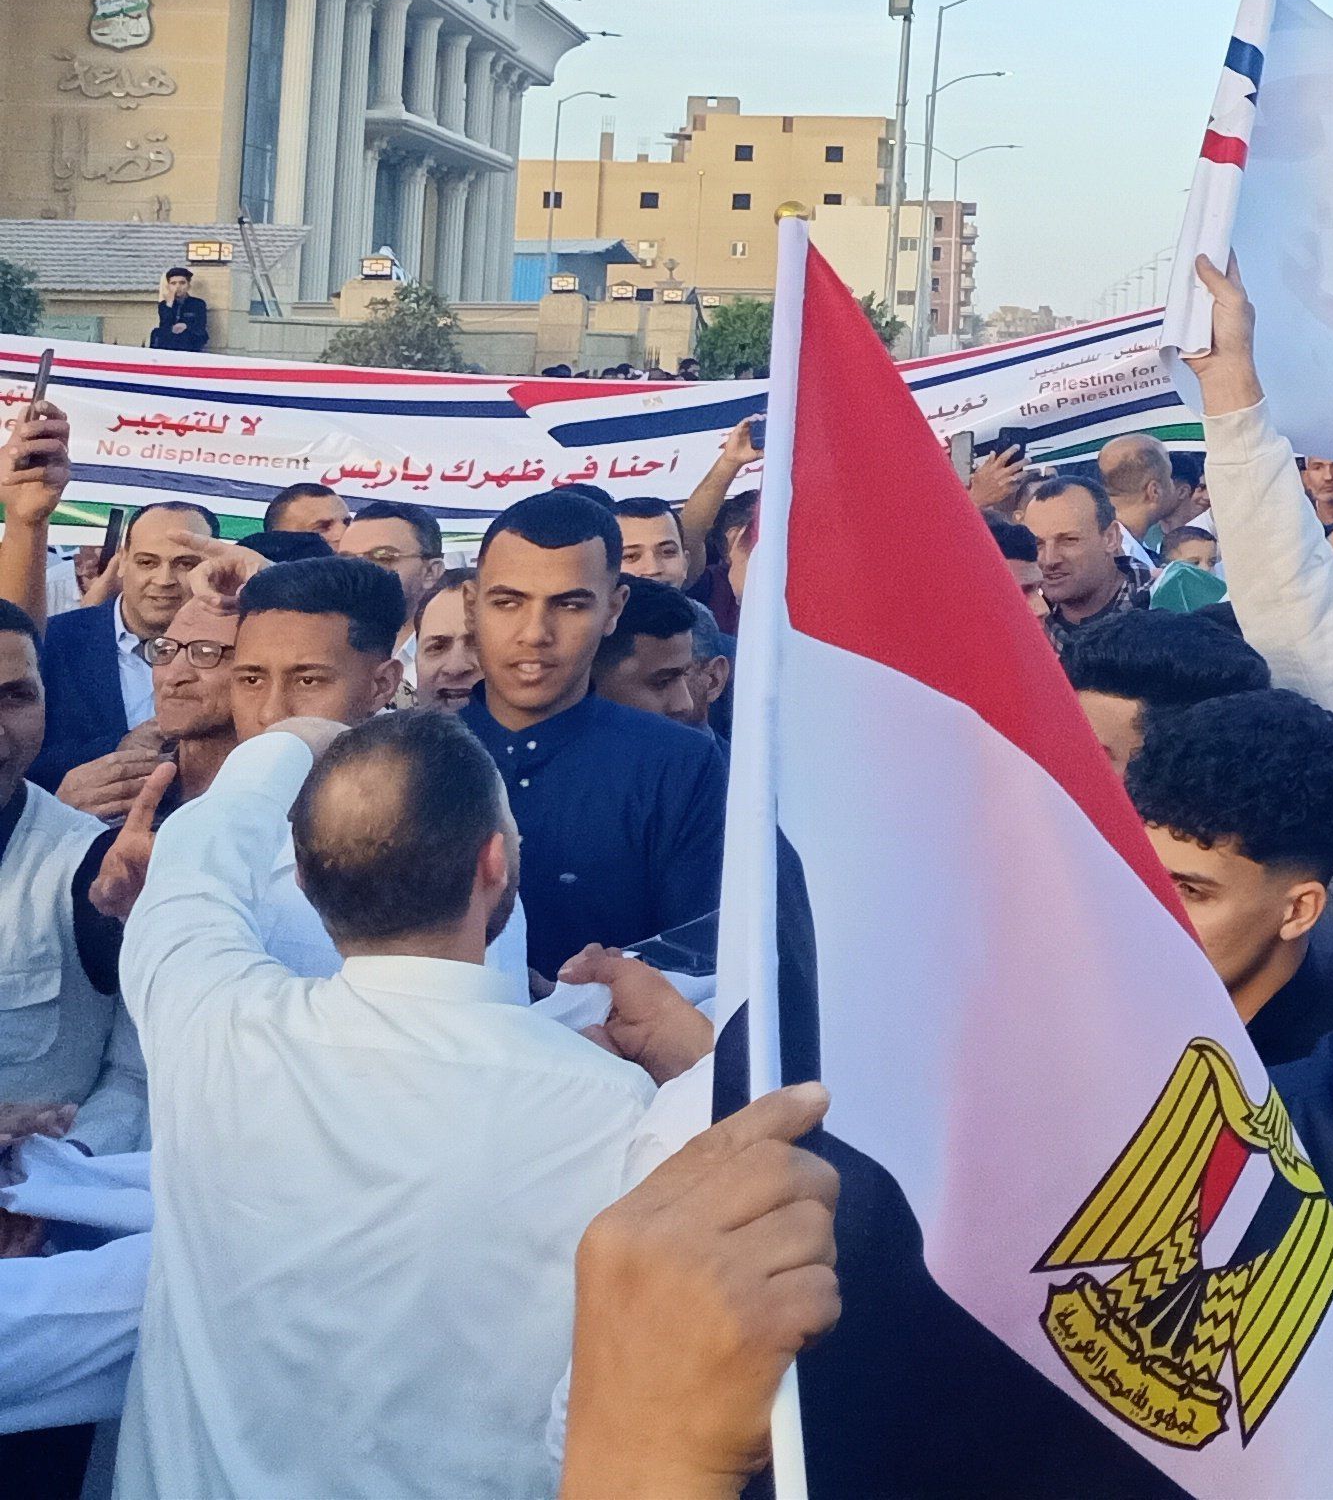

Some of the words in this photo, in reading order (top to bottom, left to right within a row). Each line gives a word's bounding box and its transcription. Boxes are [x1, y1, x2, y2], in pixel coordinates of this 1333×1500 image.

[1038, 371, 1126, 394] Palestine
[1130, 364, 1158, 379] for
[1019, 402, 1050, 417] the
[1056, 374, 1172, 409] Palestinians
[107, 411, 231, 437] للتهجير
[240, 414, 263, 436] لا
[95, 439, 131, 457] No
[140, 443, 311, 471] displacement
[439, 457, 546, 489] ظهرك
[1053, 1302, 1109, 1370] العربية
[1088, 1365, 1135, 1401] مصر
[1129, 1380, 1199, 1441] جمهورية
